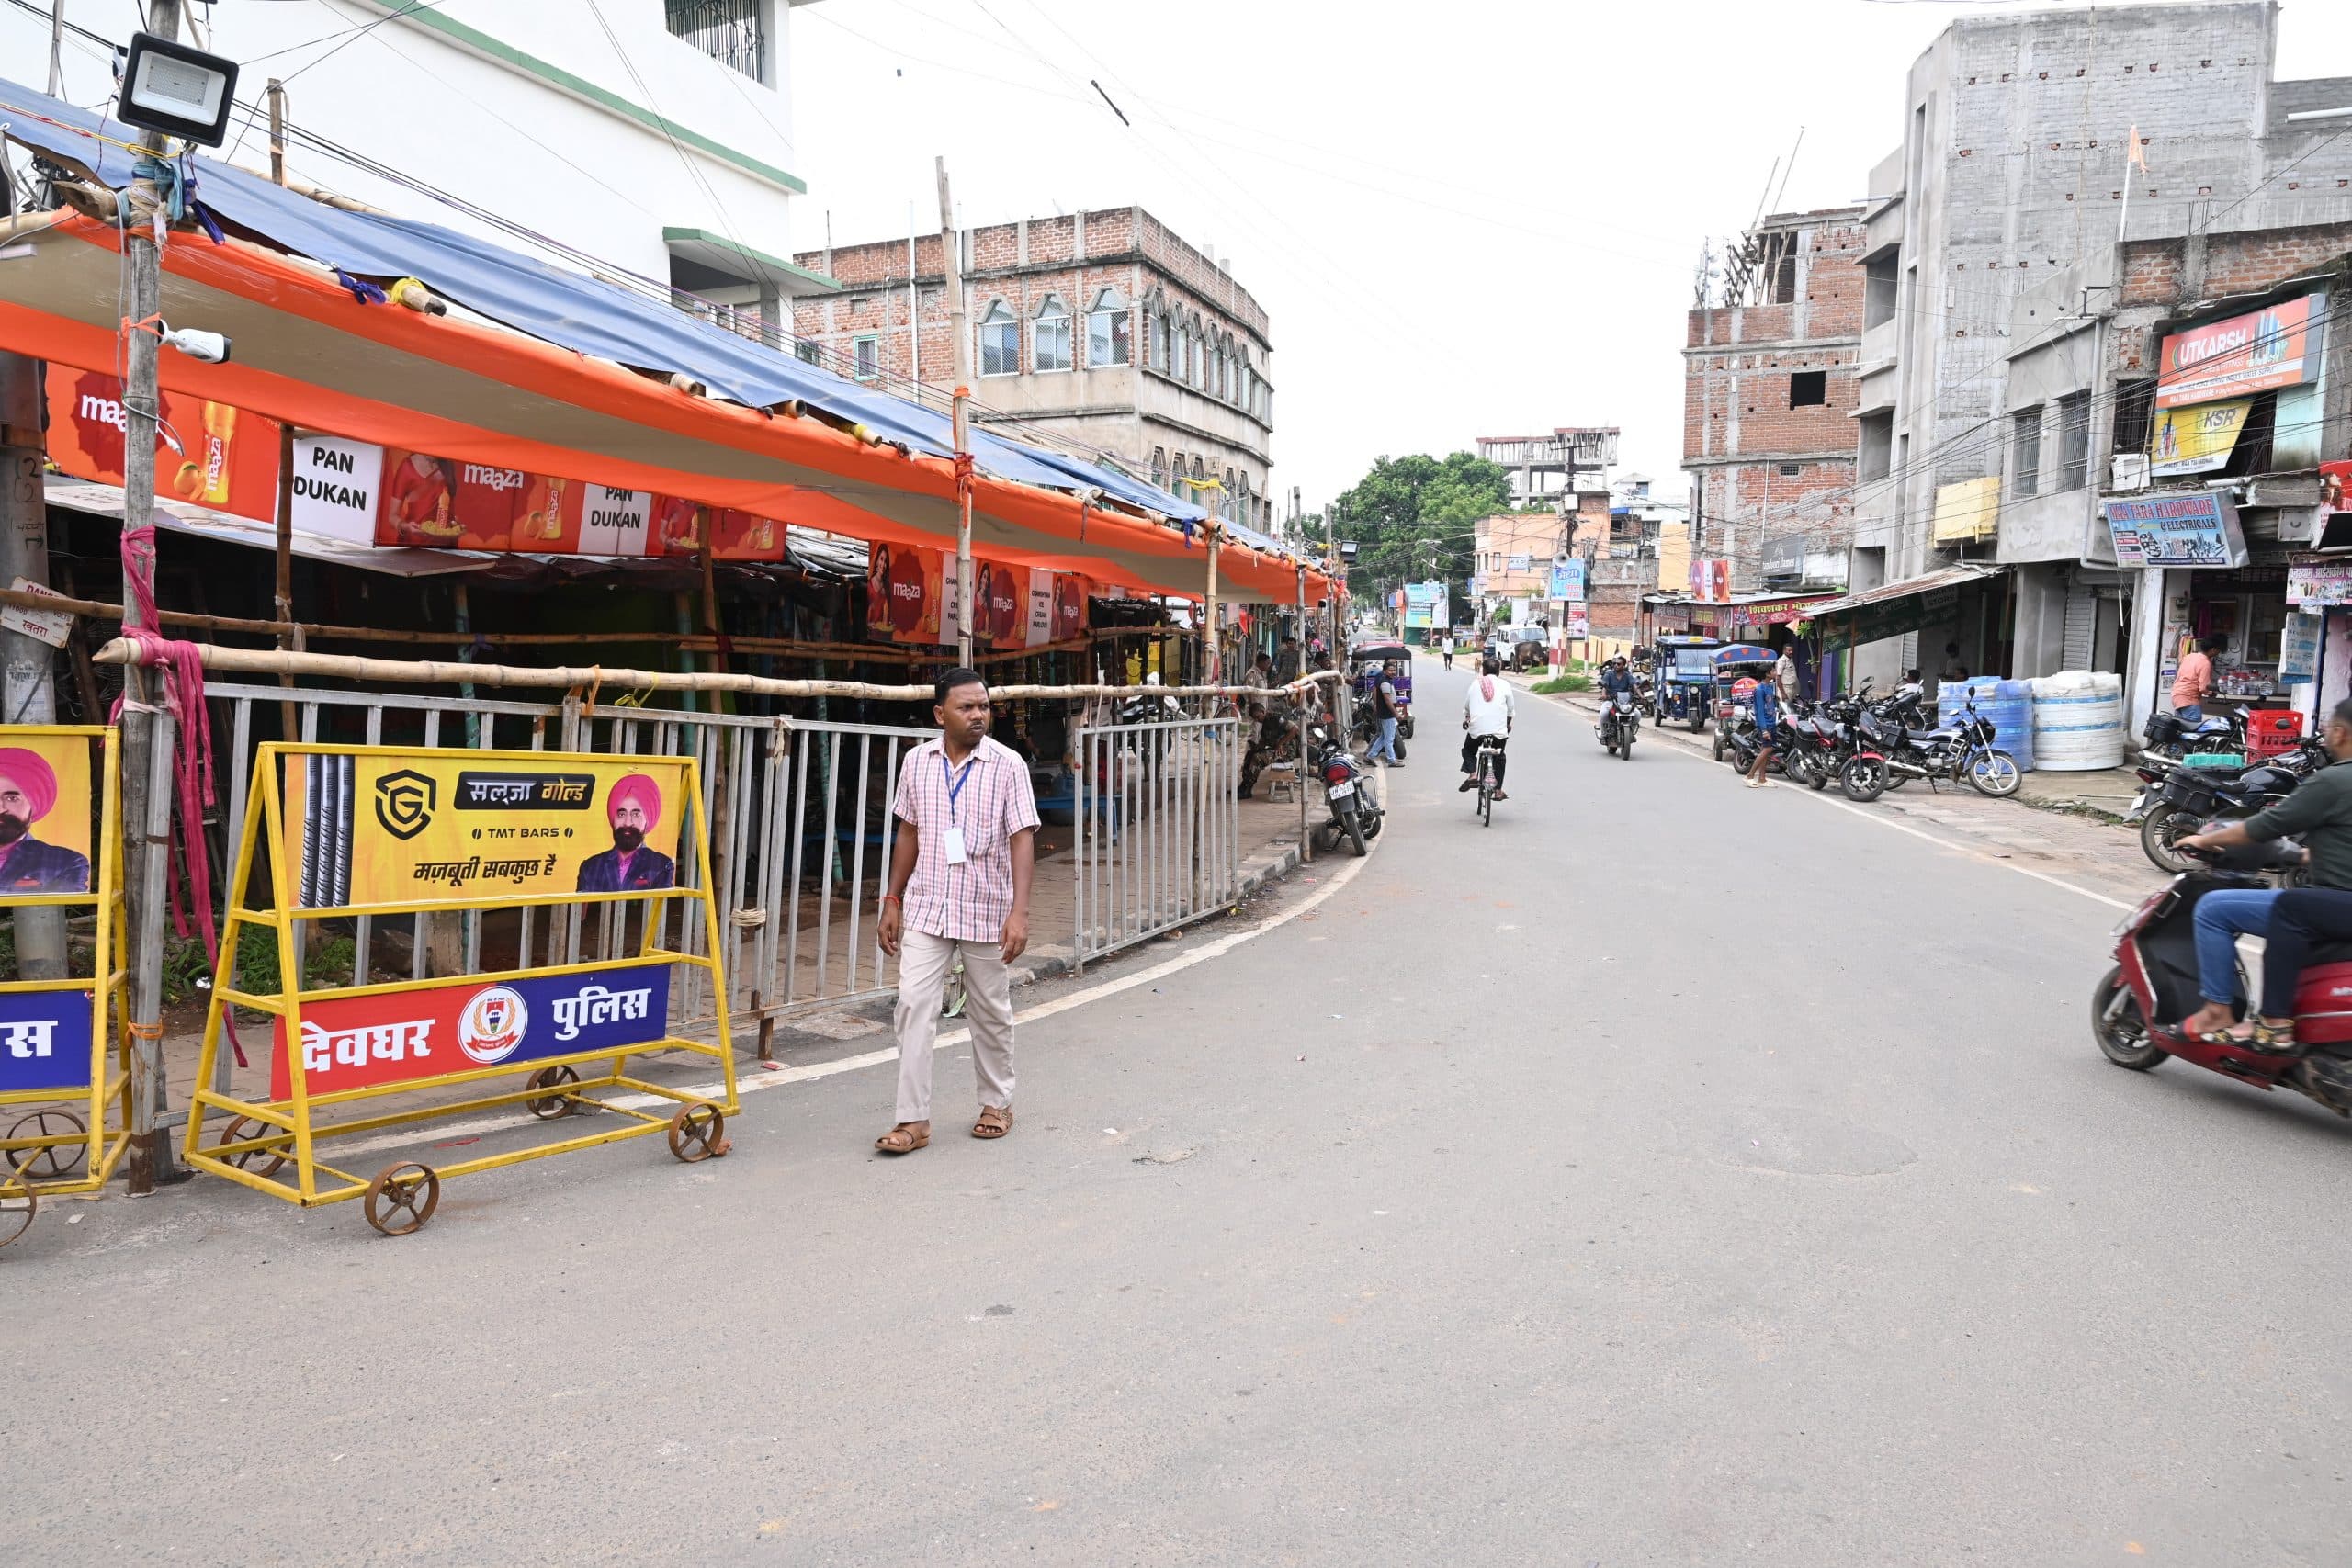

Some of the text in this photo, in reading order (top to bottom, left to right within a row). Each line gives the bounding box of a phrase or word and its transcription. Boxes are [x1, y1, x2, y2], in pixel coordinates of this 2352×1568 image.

[2179, 327, 2247, 365] UTKARSH
[2204, 408, 2236, 428] KSR
[205, 437, 222, 491] maaza
[312, 446, 354, 474] PAN
[464, 463, 524, 491] maaza
[293, 476, 367, 511] DUKAN
[605, 488, 633, 502] PAN
[591, 511, 641, 529] DUKAN
[2109, 499, 2214, 520] MAA TARA HARDWARE
[893, 582, 921, 601] maaza
[993, 596, 1013, 612] maaza
[23, 619, 49, 638] खतरा
[541, 778, 588, 801] गोल्ड
[487, 828, 560, 839] TMT BARS
[482, 859, 542, 884] सबकुछ
[543, 854, 557, 875] है
[300, 985, 652, 1073] देवघर पुलिस
